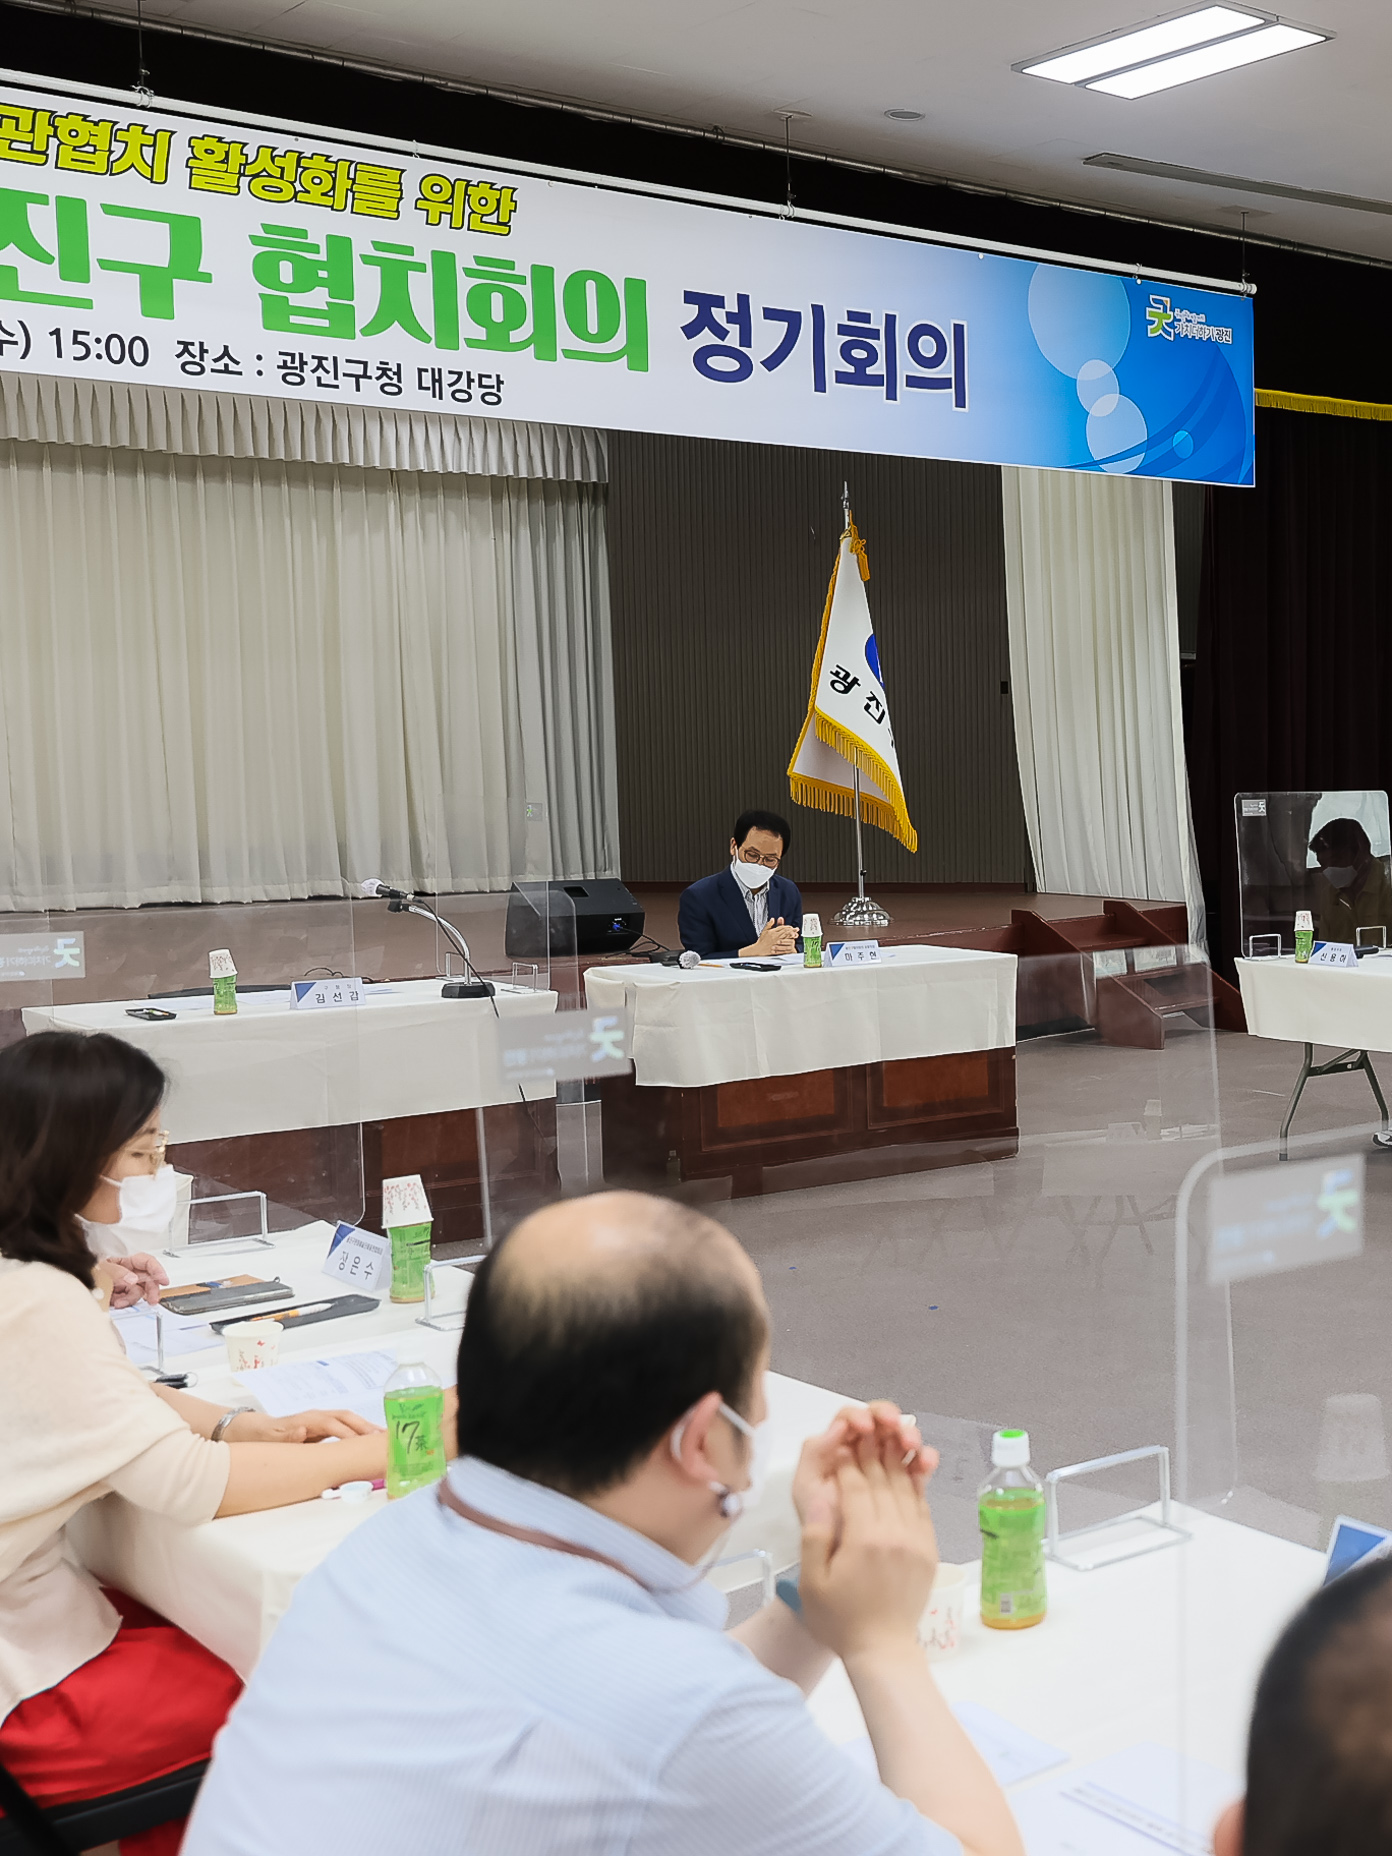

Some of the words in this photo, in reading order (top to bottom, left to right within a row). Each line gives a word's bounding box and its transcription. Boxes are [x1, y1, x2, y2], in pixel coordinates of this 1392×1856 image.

[0, 104, 177, 184] 관협치
[186, 135, 404, 219] 활성화를
[415, 172, 517, 236] 위한
[0, 187, 213, 321] 진구
[249, 222, 650, 373] 협치회의
[680, 288, 968, 412] 정기회의
[48, 327, 150, 367] 15:00
[175, 339, 242, 377] 장소
[276, 350, 404, 396] 광진구청
[416, 364, 504, 406] 대강당
